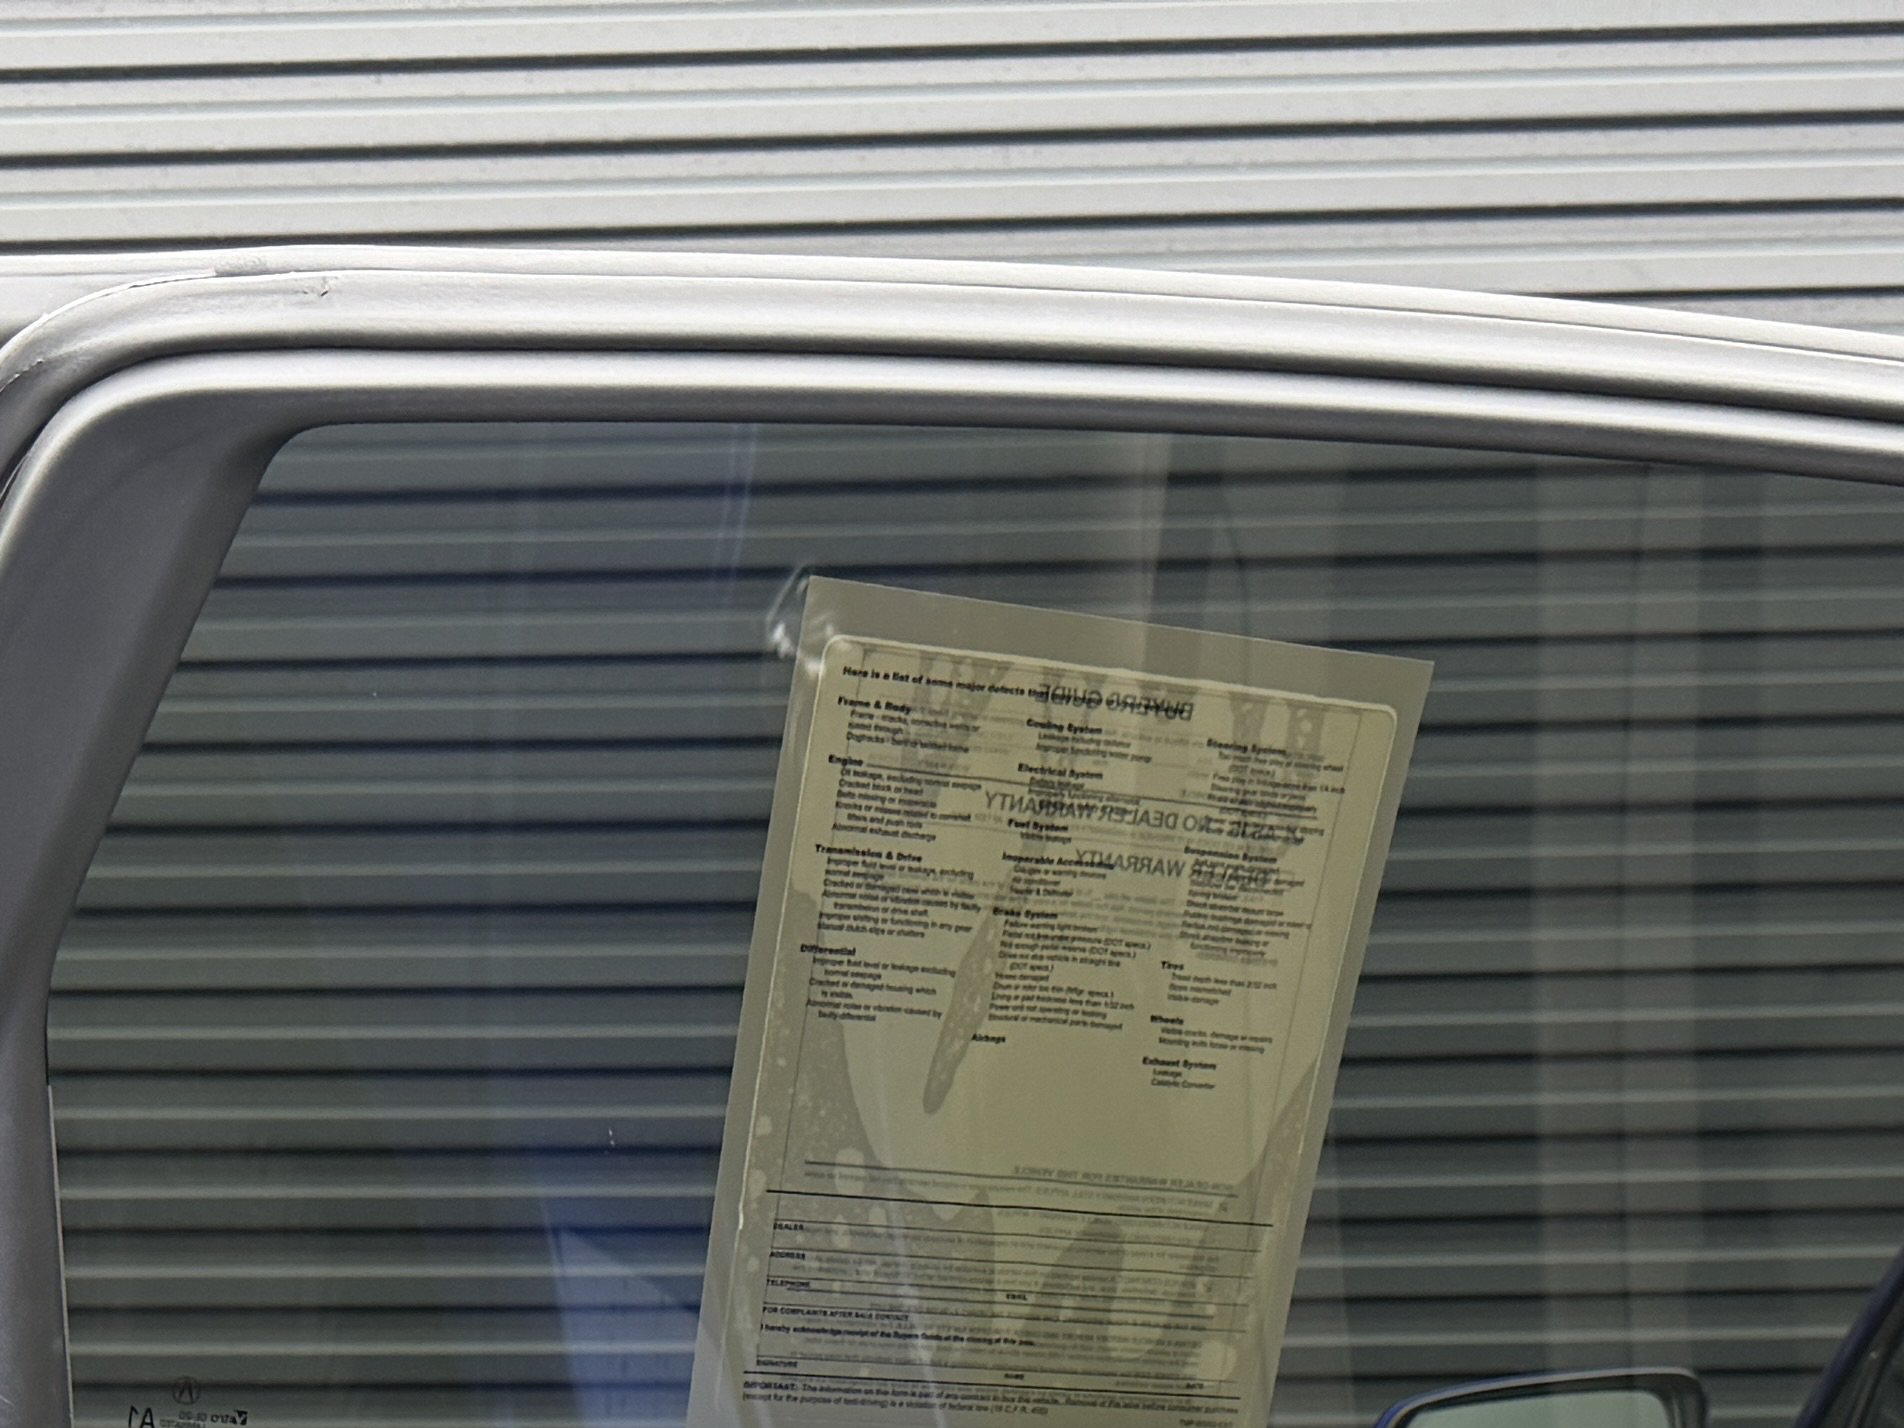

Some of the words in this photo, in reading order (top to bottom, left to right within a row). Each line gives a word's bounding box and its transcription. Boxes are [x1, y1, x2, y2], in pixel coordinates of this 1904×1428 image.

[842, 665, 869, 677] Here
[870, 668, 881, 679] is
[891, 670, 910, 682] list
[911, 673, 923, 684] of
[925, 674, 954, 687] some
[955, 678, 986, 691] major
[987, 681, 1025, 695] defects
[837, 695, 871, 709] Frame
[873, 699, 882, 710] &
[883, 700, 912, 714] Body
[1025, 718, 1065, 731] Cooling
[1066, 722, 1103, 736] System
[1206, 738, 1248, 751] Steering
[1251, 743, 1286, 756] System
[827, 754, 864, 768] Engine
[1017, 762, 1067, 776] Electrical
[1068, 768, 1103, 780] System
[1007, 818, 1029, 829] Fuel
[1031, 820, 1069, 833] System
[814, 843, 883, 858] Transmission
[884, 850, 894, 859] &
[895, 851, 923, 862] Drive
[1001, 851, 1055, 865] Inoperable
[1183, 845, 1239, 860] Suspension
[1242, 851, 1277, 864] System
[992, 906, 1021, 917] Brake
[1023, 910, 1058, 921] System
[799, 943, 856, 956] Differential
[1160, 960, 1184, 970] Tires
[1149, 1014, 1184, 1025] Wheels
[971, 1033, 1006, 1044] Airbags
[1141, 1056, 1180, 1067] Exhaust
[1182, 1059, 1217, 1070] System
[742, 1391, 771, 1400] (except
[772, 1393, 783, 1401] for
[785, 1393, 797, 1402] the
[799, 1394, 831, 1404] purpose
[833, 1396, 842, 1404] of
[889, 1399, 896, 1407] is
[938, 1402, 946, 1410] of
[974, 1404, 989, 1412] law
